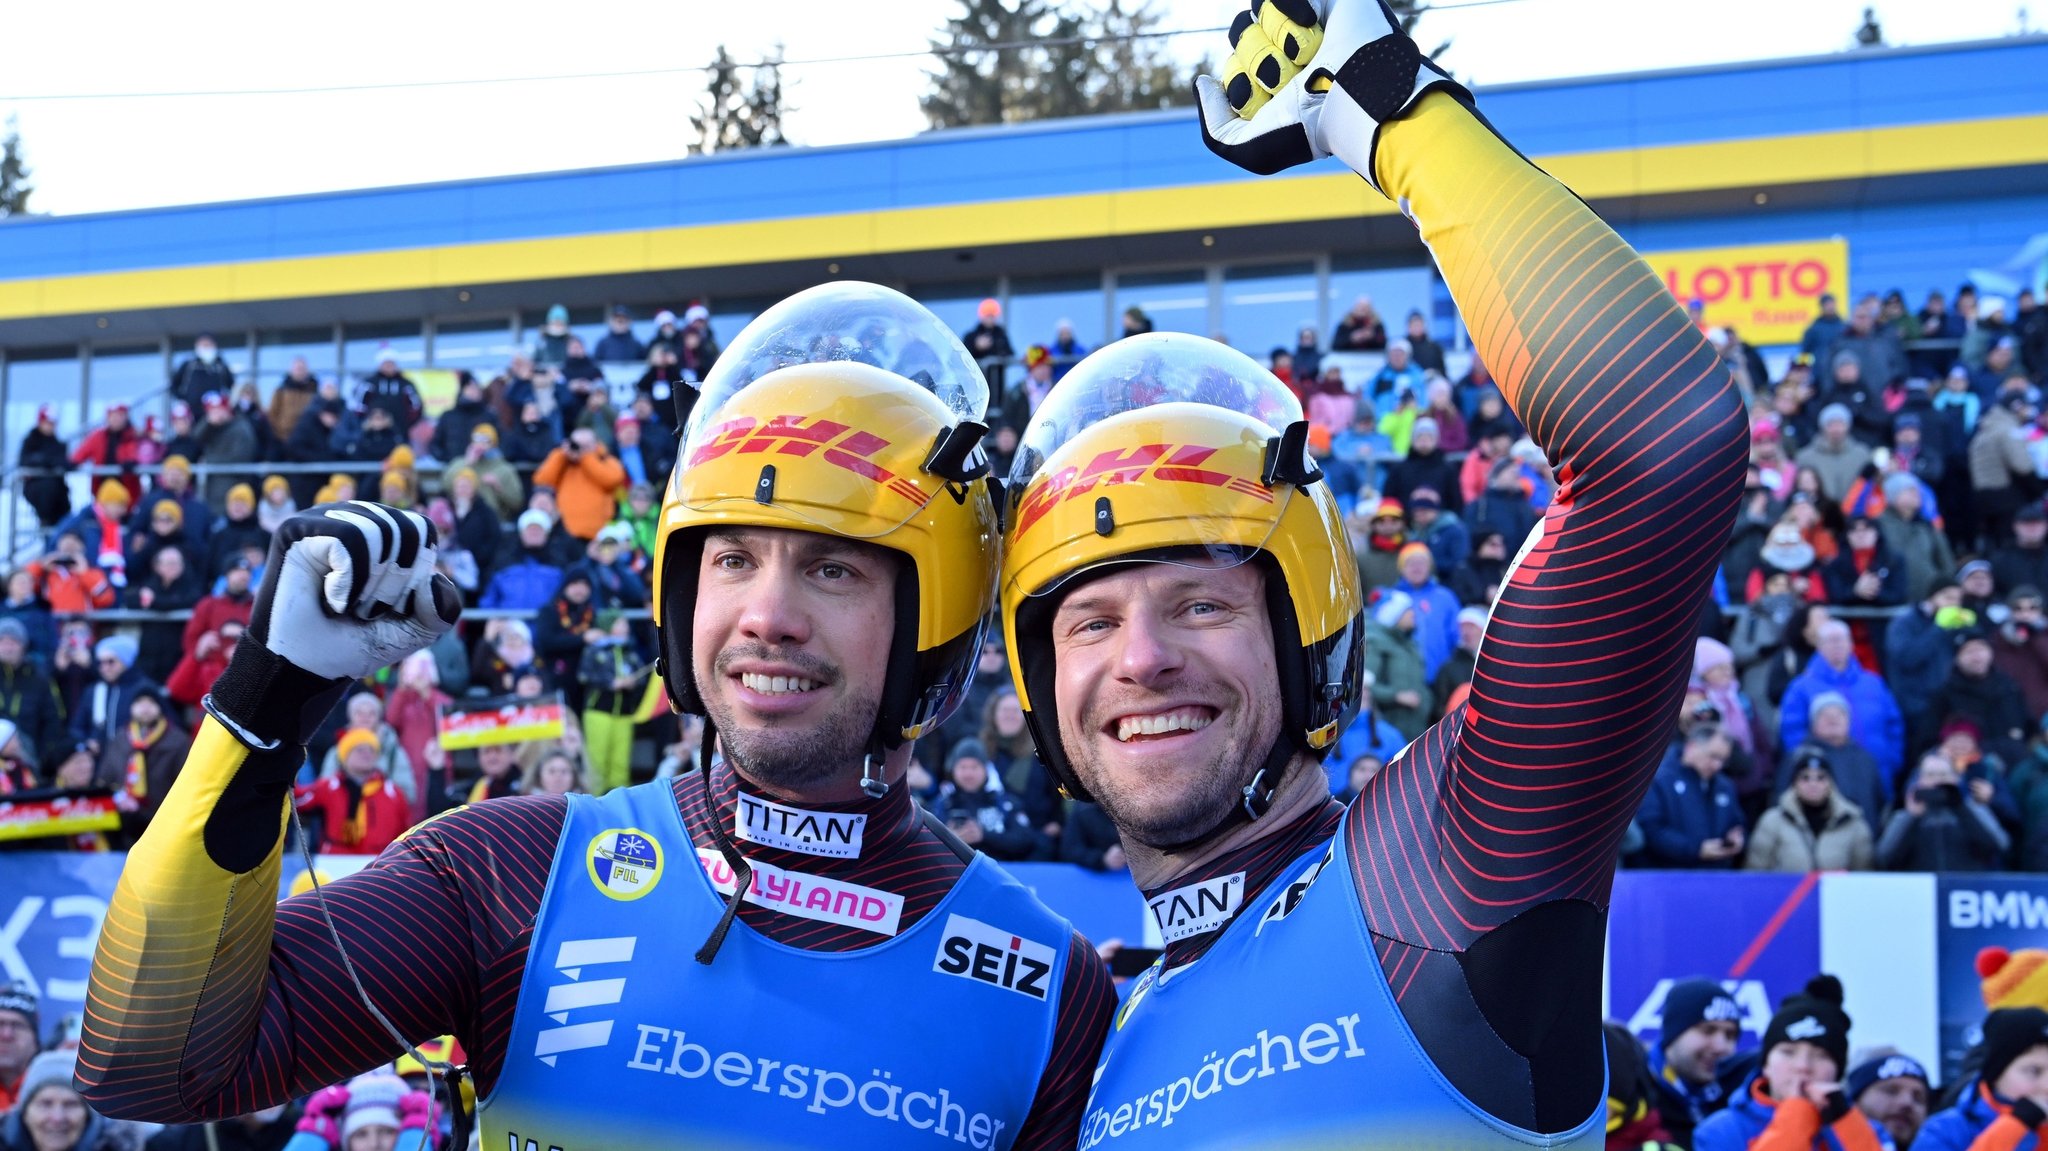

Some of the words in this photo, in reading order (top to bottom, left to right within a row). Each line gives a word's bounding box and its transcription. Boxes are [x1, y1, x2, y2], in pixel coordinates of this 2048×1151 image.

[1667, 259, 1829, 304] LOTTO
[688, 415, 896, 484] DHL
[1013, 444, 1233, 543] DHL
[613, 865, 639, 884] FIL
[746, 833, 773, 844] MADE
[797, 845, 849, 856] GERMANY
[699, 856, 887, 922] ULYLAND
[1949, 889, 2048, 930] BMW
[627, 1023, 1006, 1151] Eberspächer
[1080, 1013, 1366, 1151] Eberspächer
